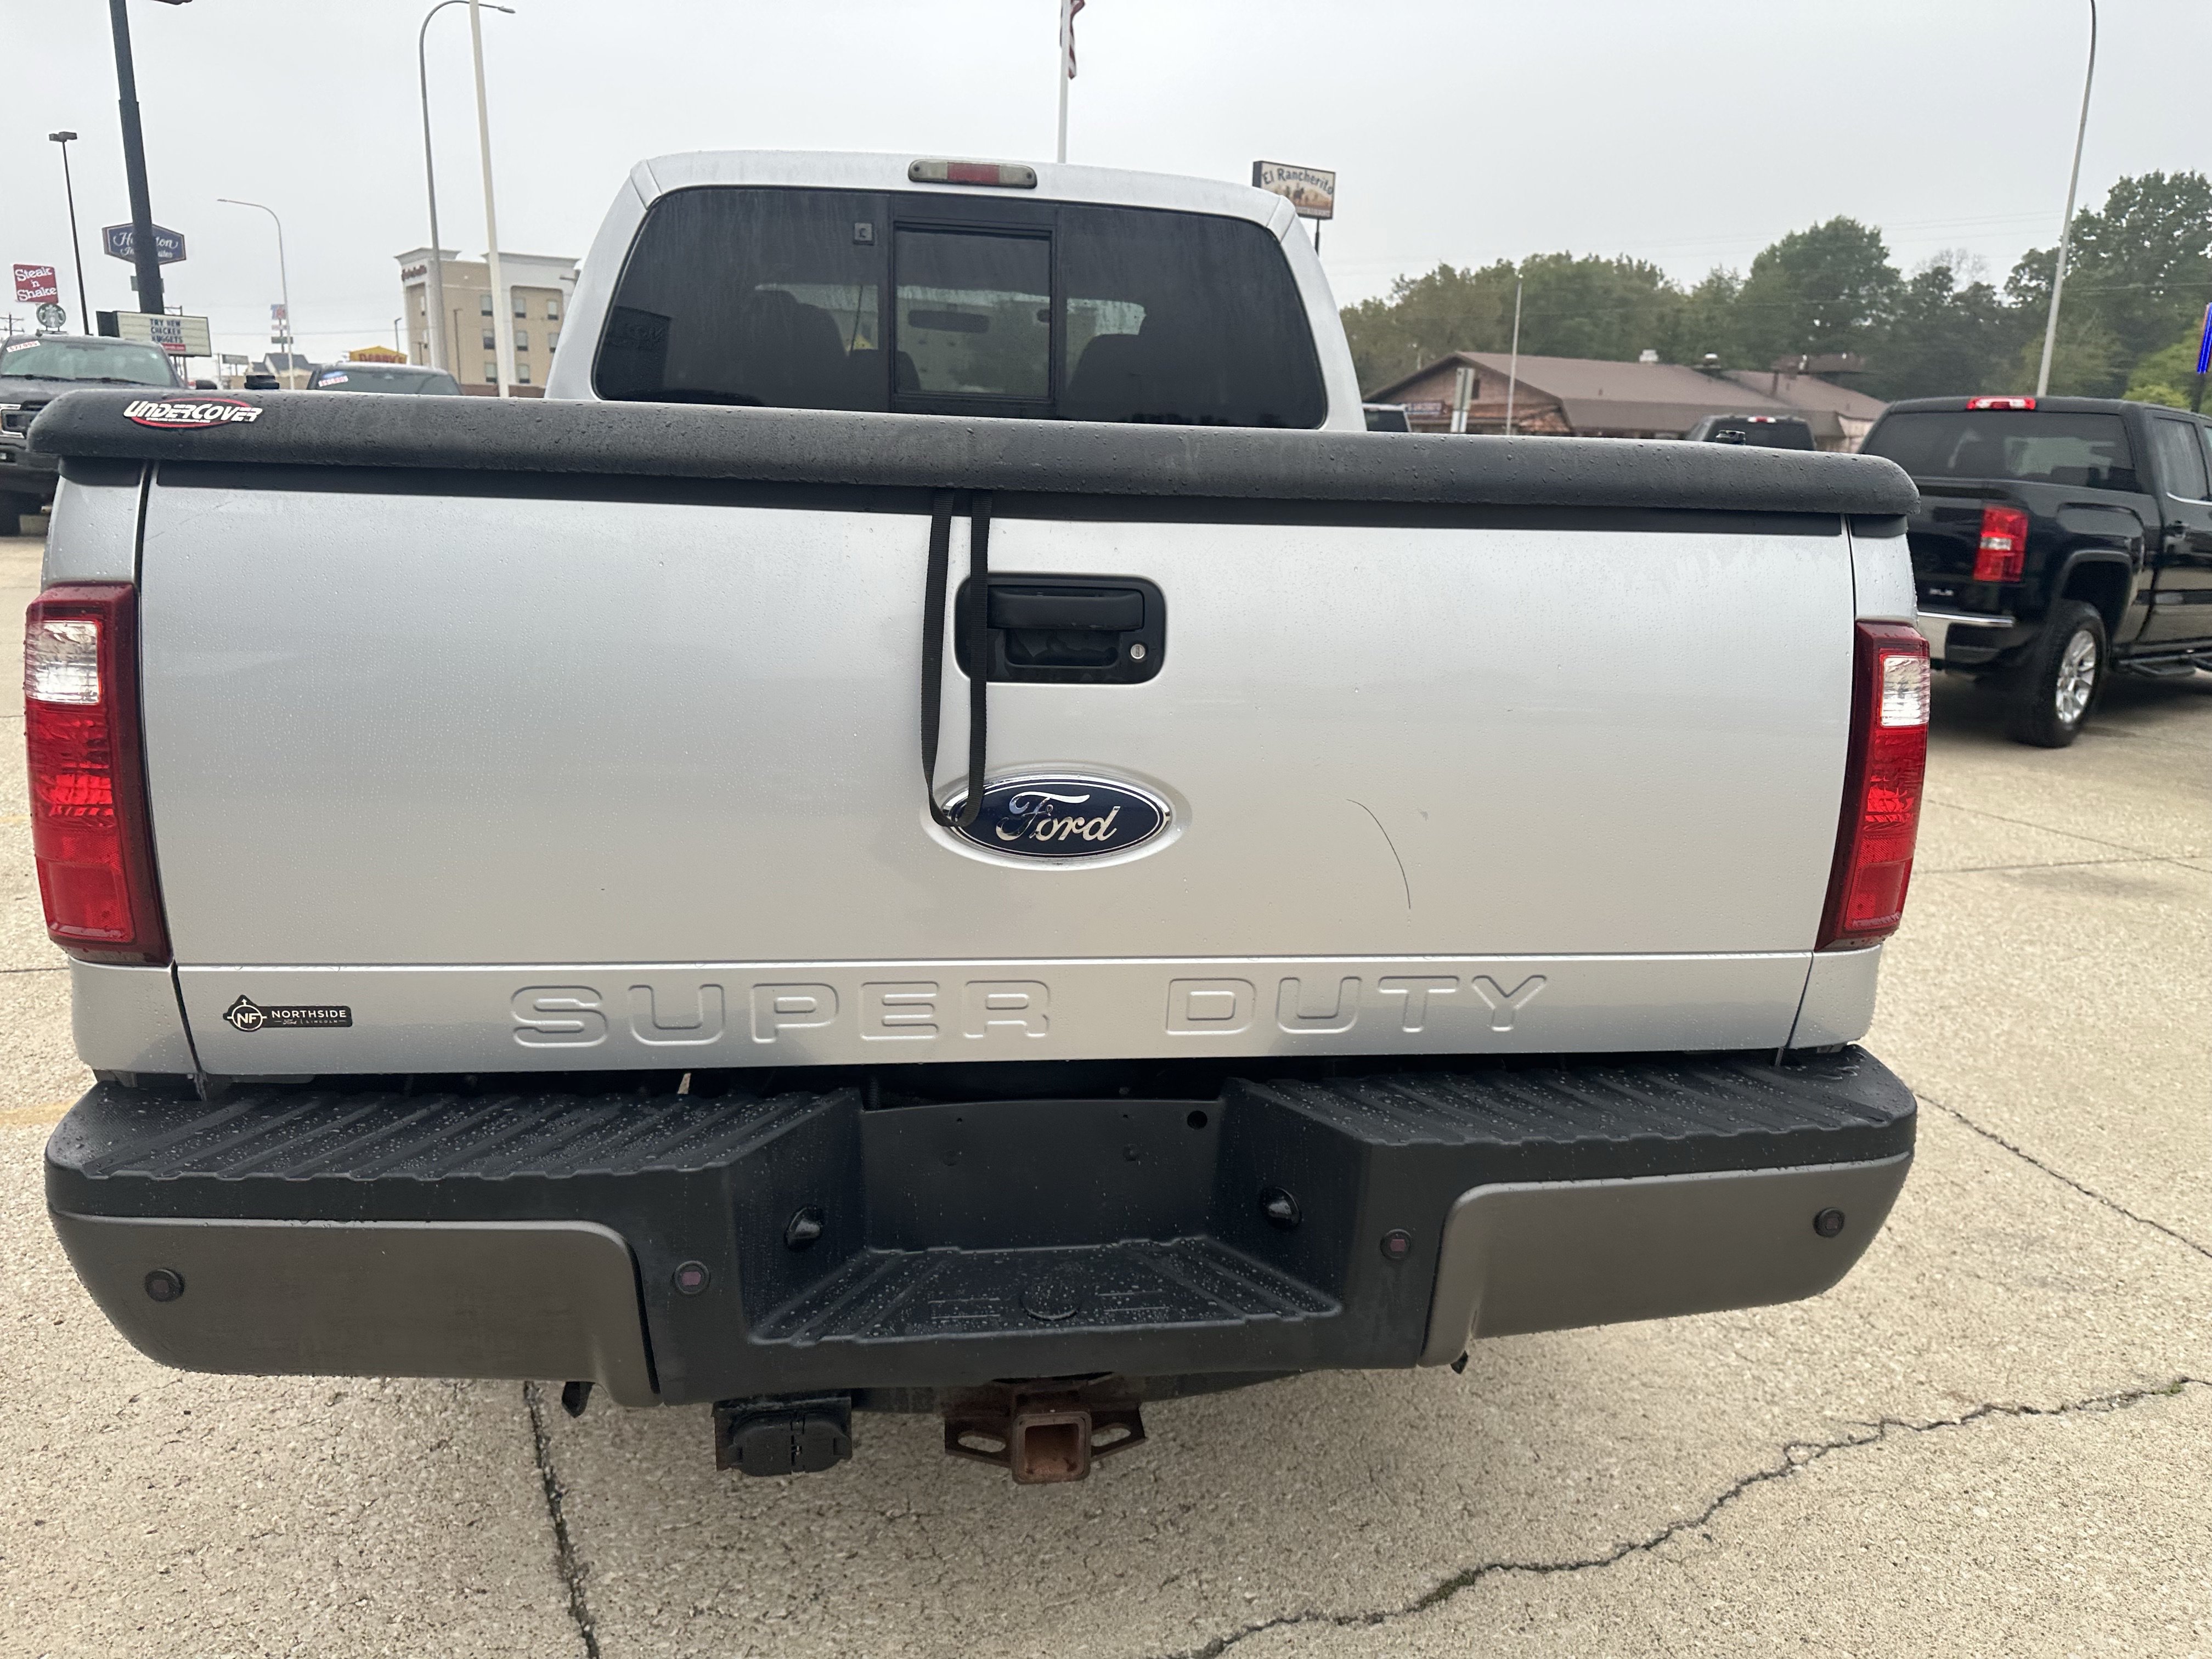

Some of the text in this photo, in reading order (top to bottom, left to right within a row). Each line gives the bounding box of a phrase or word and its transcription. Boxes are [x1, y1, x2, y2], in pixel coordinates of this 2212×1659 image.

[1263, 168, 1334, 195] El Rancherito
[113, 232, 178, 249] Hton
[15, 267, 53, 281] Steak
[17, 287, 57, 301] Shake
[123, 400, 263, 422] UNDERCOVER
[996, 791, 1121, 842] Ford
[271, 1010, 347, 1019] NORTHSIDE
[510, 975, 1548, 1048] SUPER DUTY
